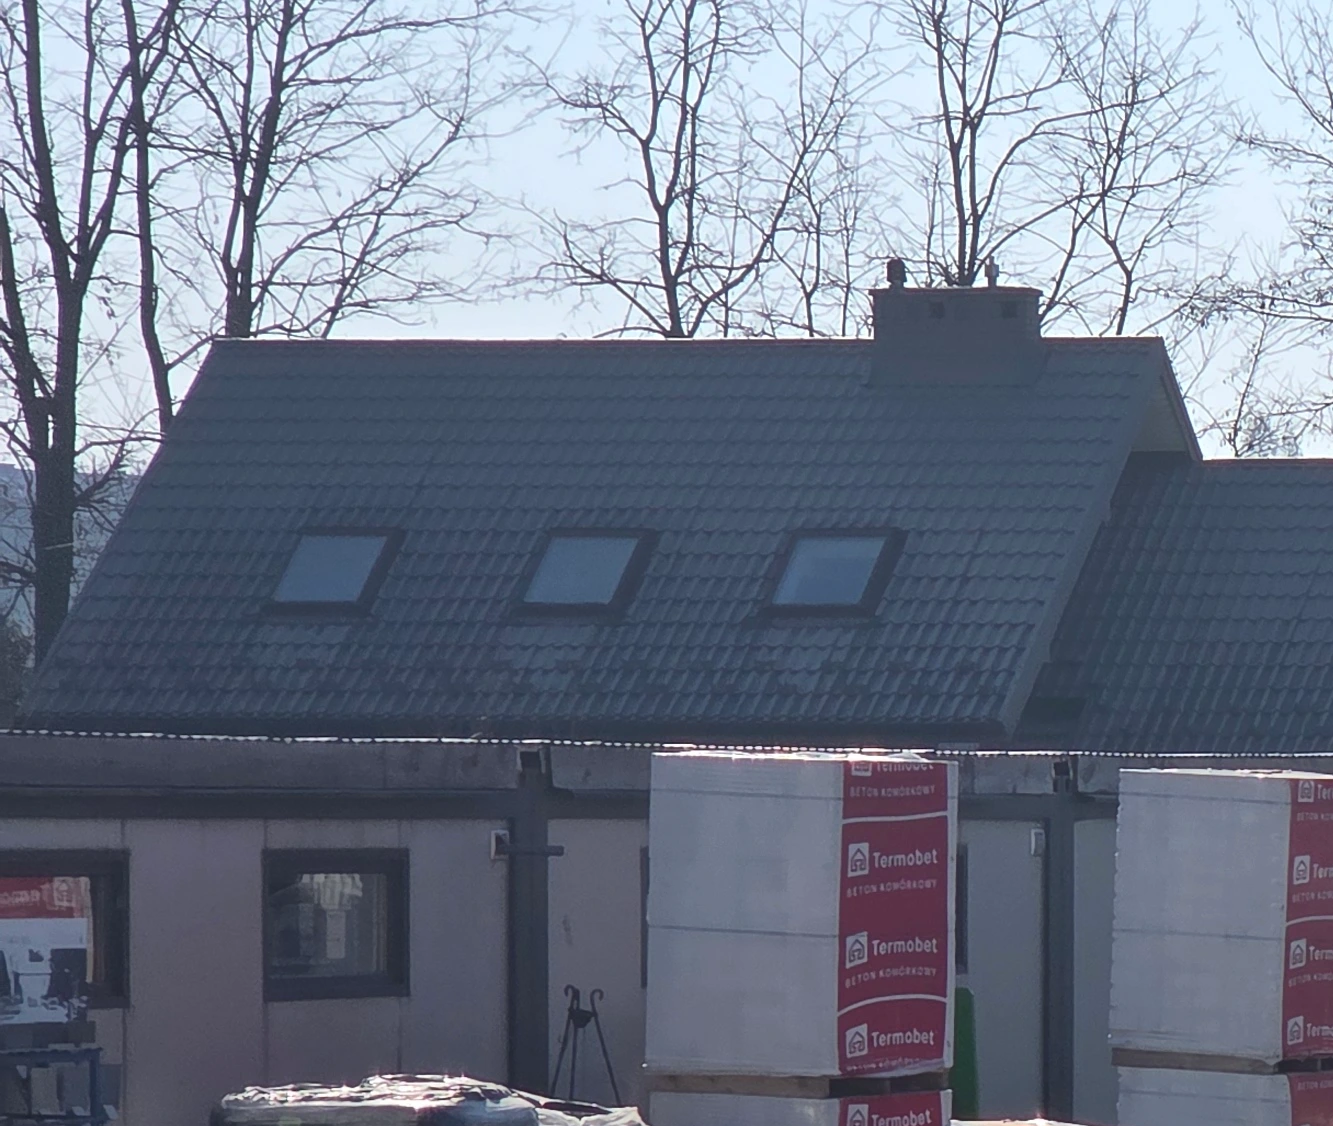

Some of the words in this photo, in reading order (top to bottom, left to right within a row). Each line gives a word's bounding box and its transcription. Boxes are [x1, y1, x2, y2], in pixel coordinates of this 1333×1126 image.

[872, 848, 938, 869] Termobet
[871, 936, 939, 956] Termobet
[871, 1027, 935, 1048] Termobet
